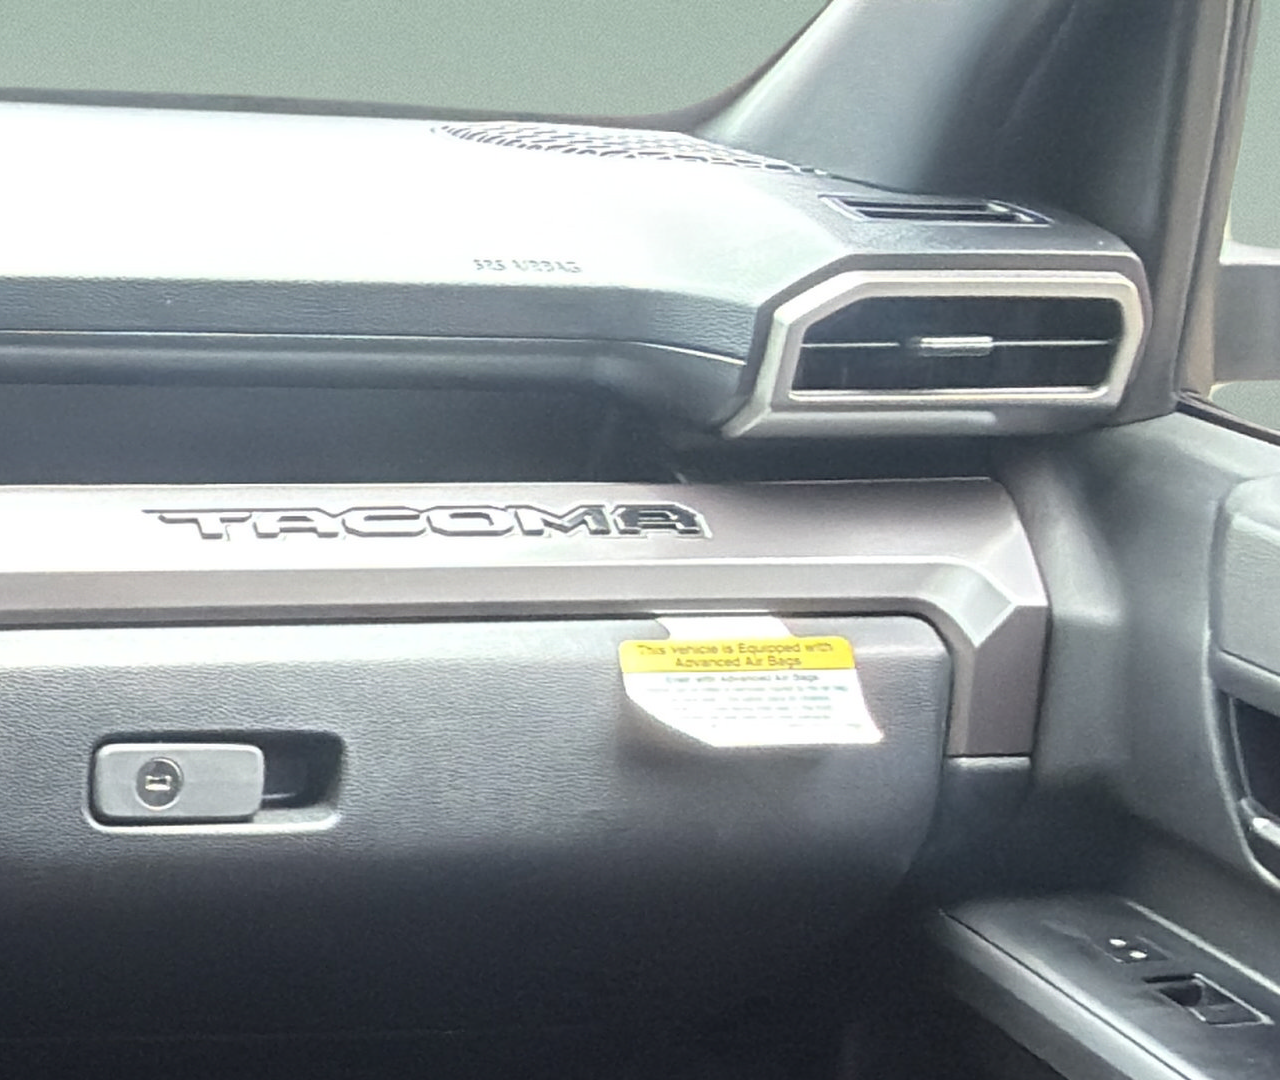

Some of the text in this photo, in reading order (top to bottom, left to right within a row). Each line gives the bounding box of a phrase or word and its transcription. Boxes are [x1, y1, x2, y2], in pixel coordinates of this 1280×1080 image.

[142, 503, 710, 539] TACOMA
[638, 644, 667, 656] This
[722, 643, 734, 655] is
[738, 642, 801, 655] Equipped
[804, 641, 834, 653] with
[675, 656, 802, 669] Advanced Air Bags
